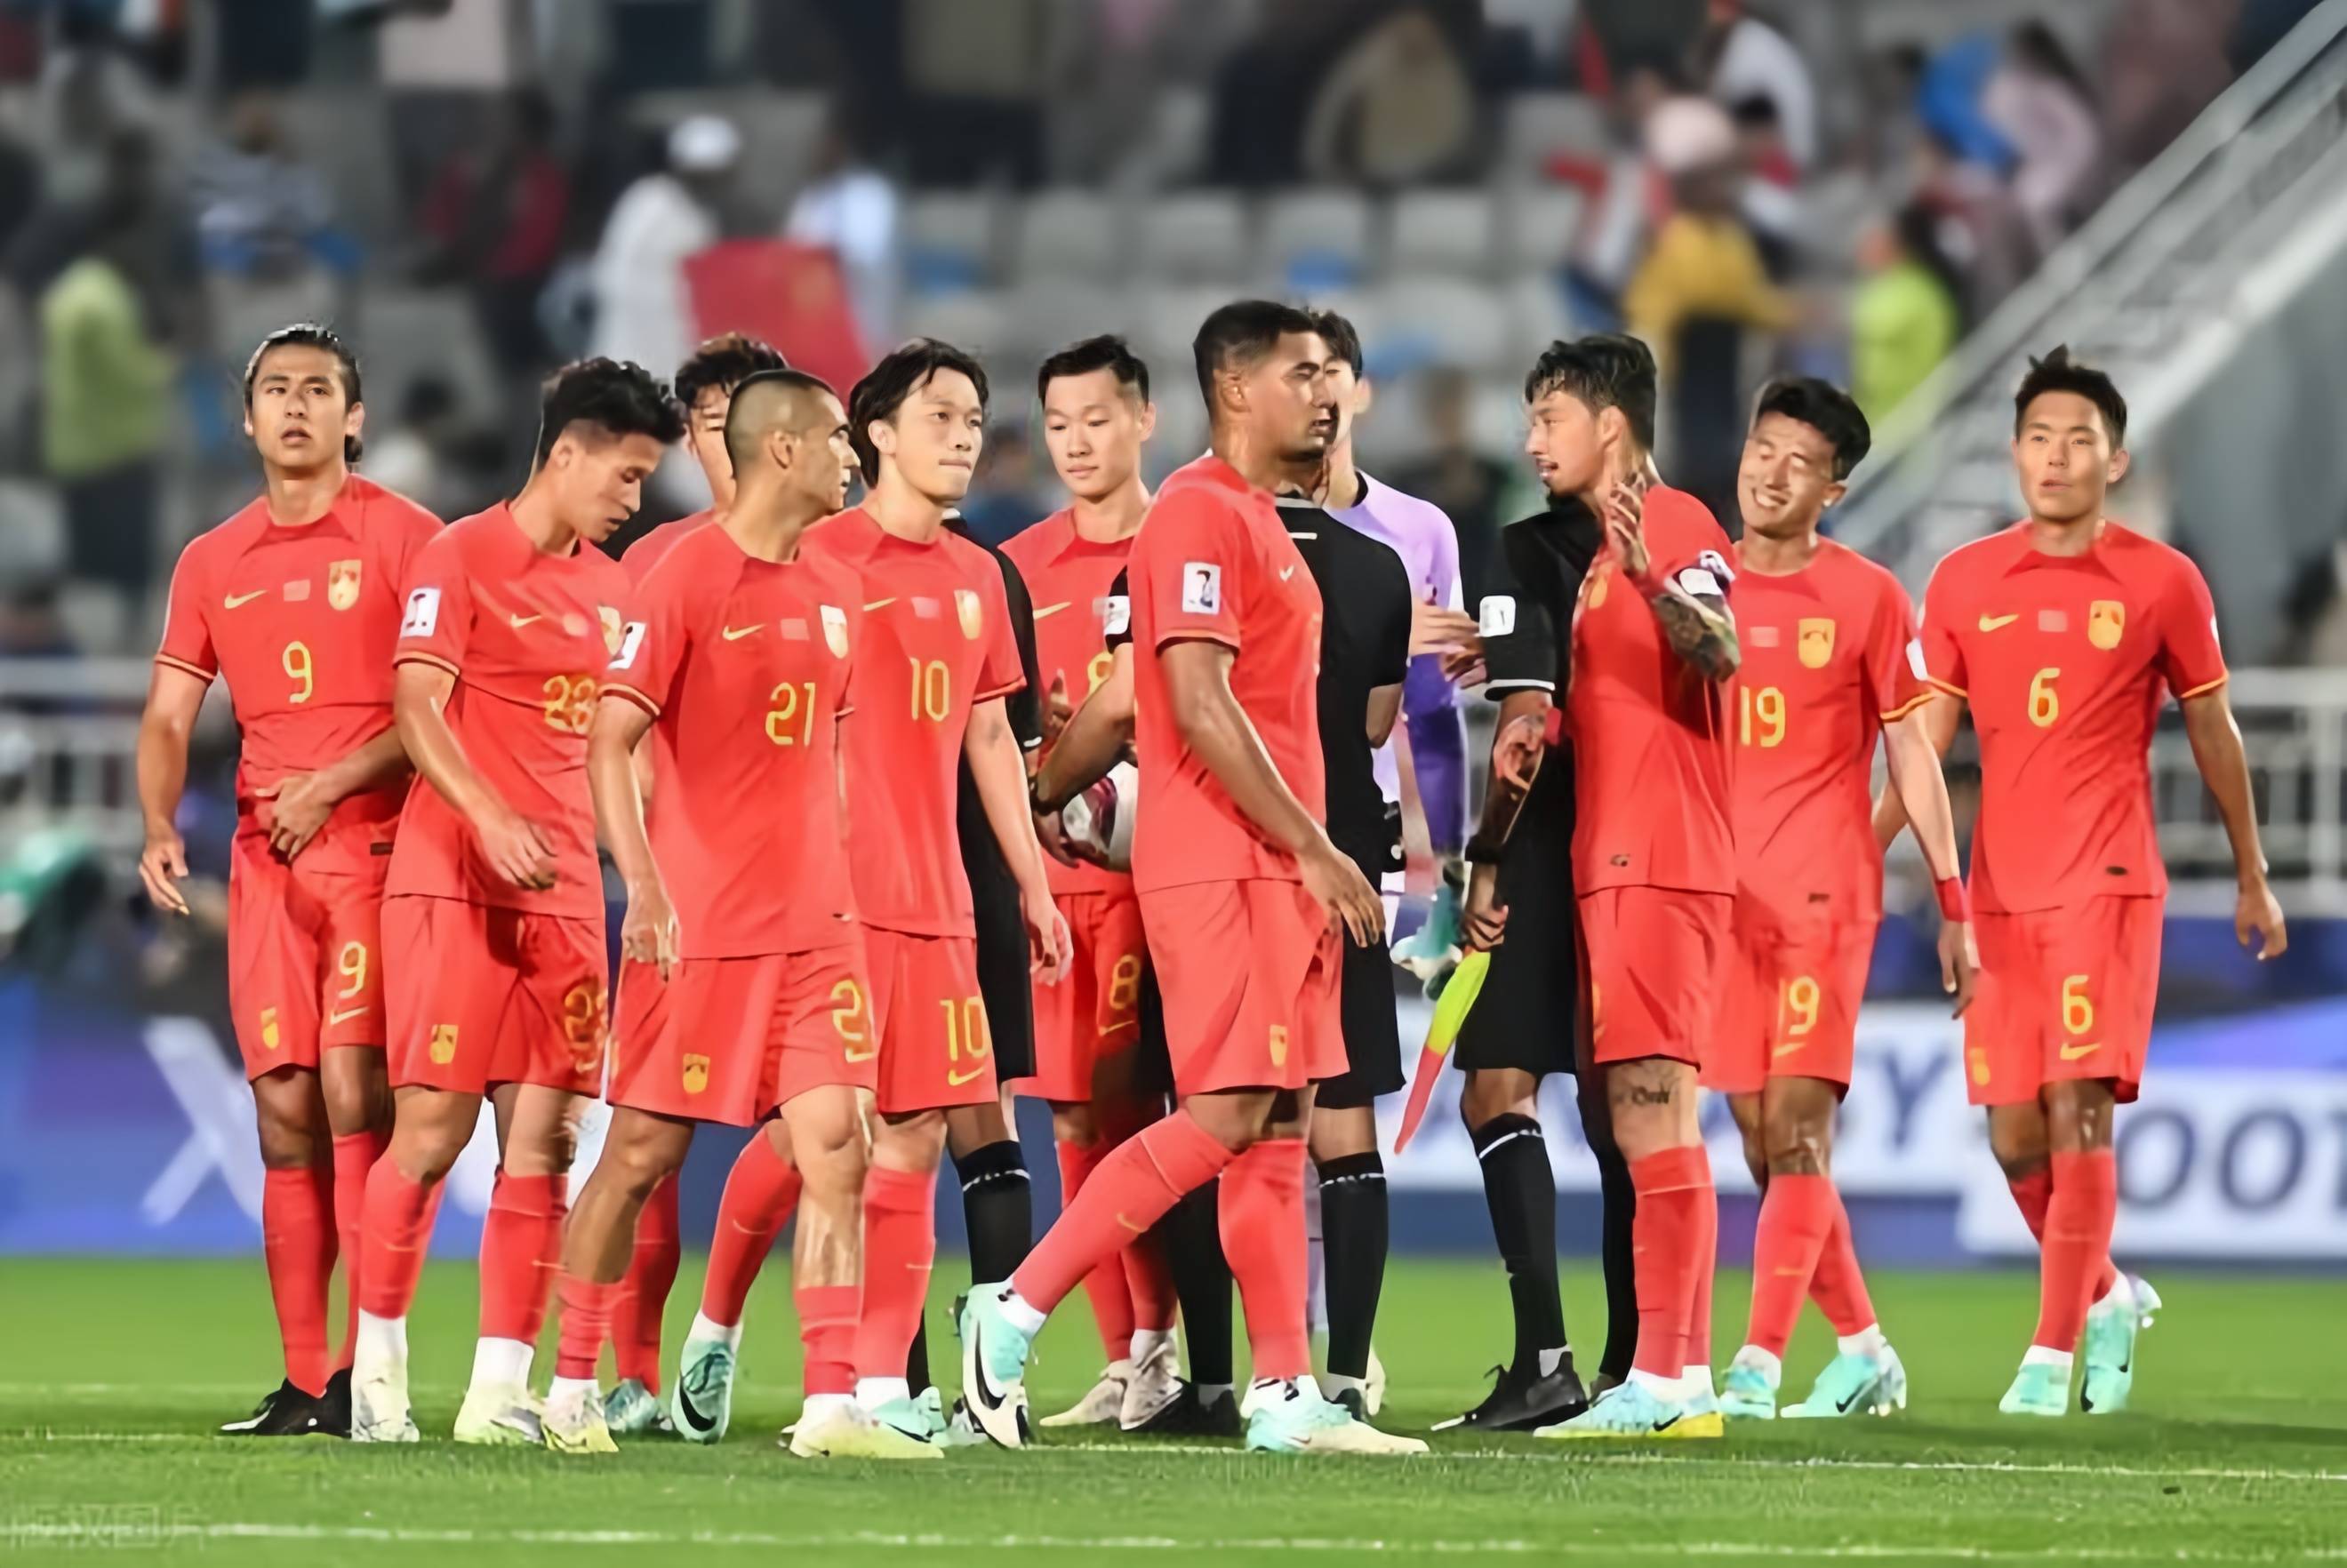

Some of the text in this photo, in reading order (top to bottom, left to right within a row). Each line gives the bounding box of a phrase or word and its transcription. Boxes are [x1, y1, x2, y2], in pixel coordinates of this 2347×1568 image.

[282, 640, 314, 704] 9
[910, 658, 950, 723] 10
[2028, 668, 2061, 727] 6
[765, 682, 816, 746] 21
[1740, 685, 1786, 748] 19
[338, 940, 367, 998] 9
[1109, 954, 1140, 1010] 8
[939, 996, 989, 1060] 10
[2062, 974, 2093, 1035] 6
